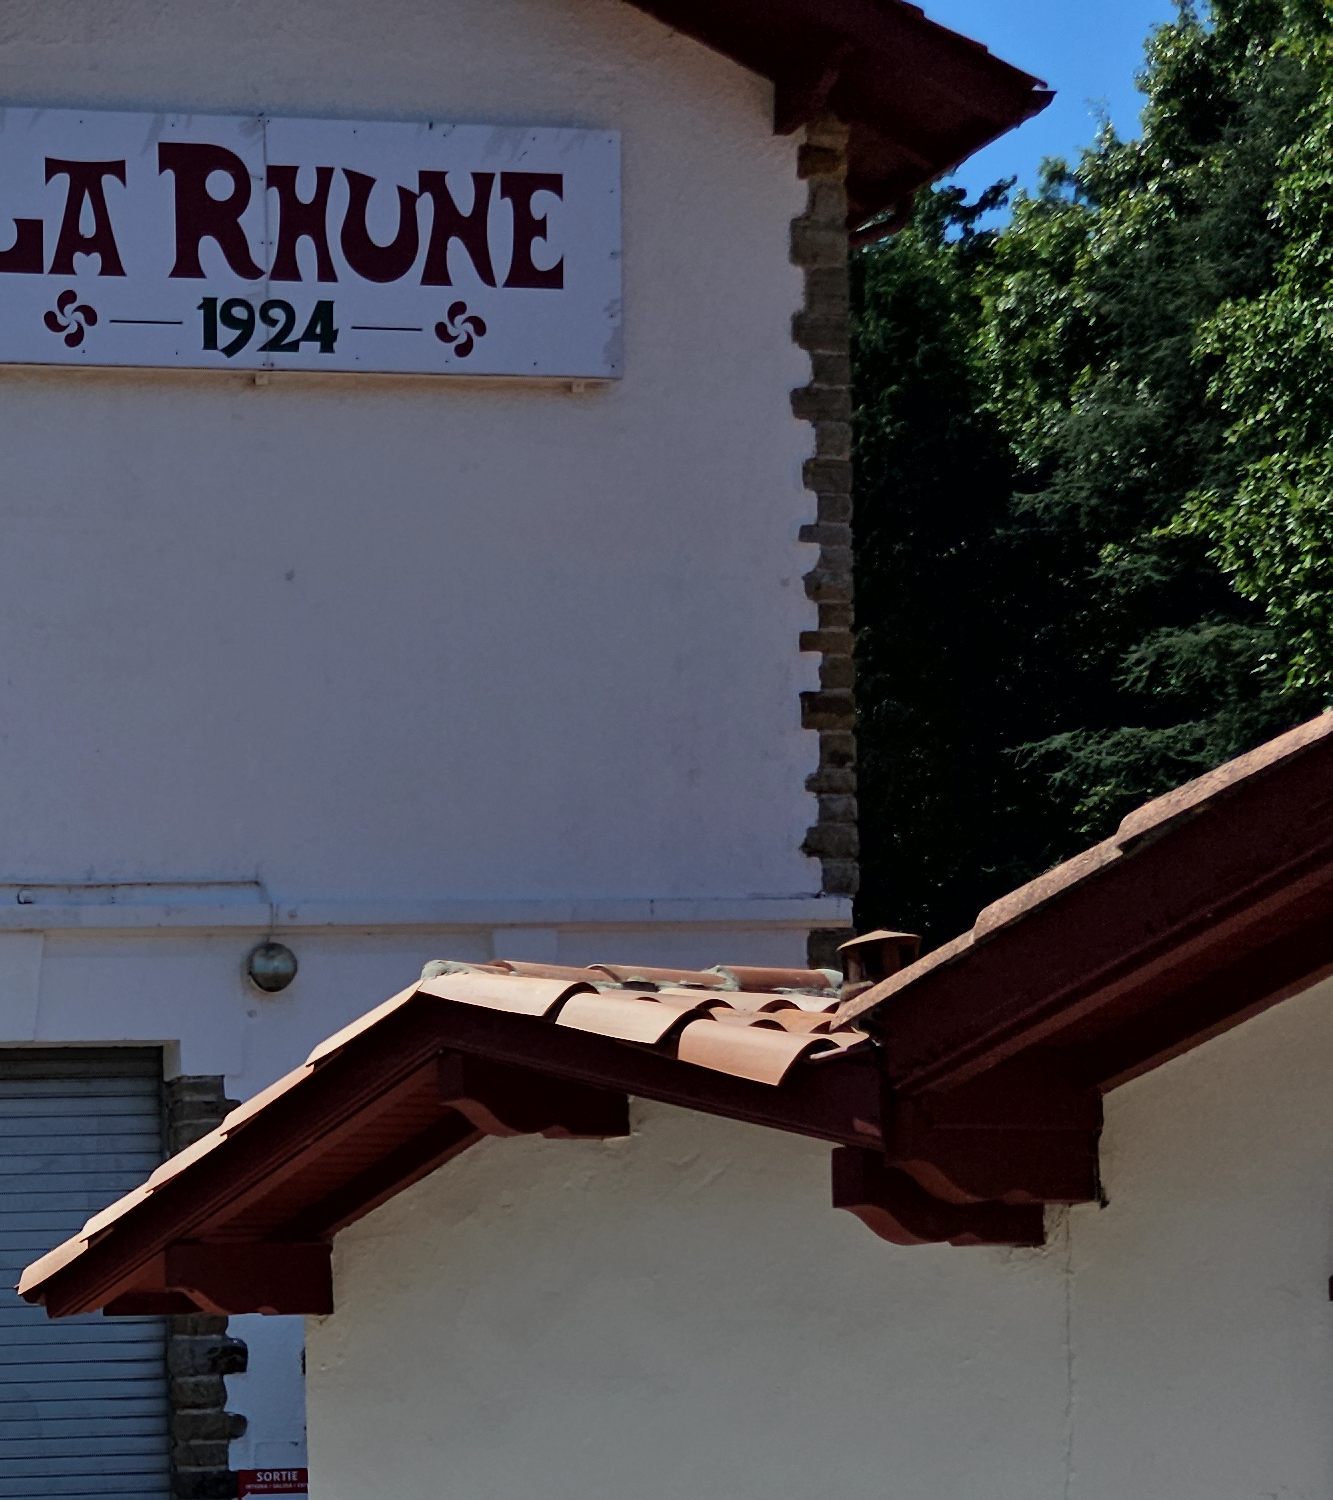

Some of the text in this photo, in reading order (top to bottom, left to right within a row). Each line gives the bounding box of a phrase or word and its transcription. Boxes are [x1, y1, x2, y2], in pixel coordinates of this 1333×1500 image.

[157, 141, 565, 291] RHUNE
[198, 297, 339, 358] 1924
[256, 1471, 298, 1482] SORTIE
